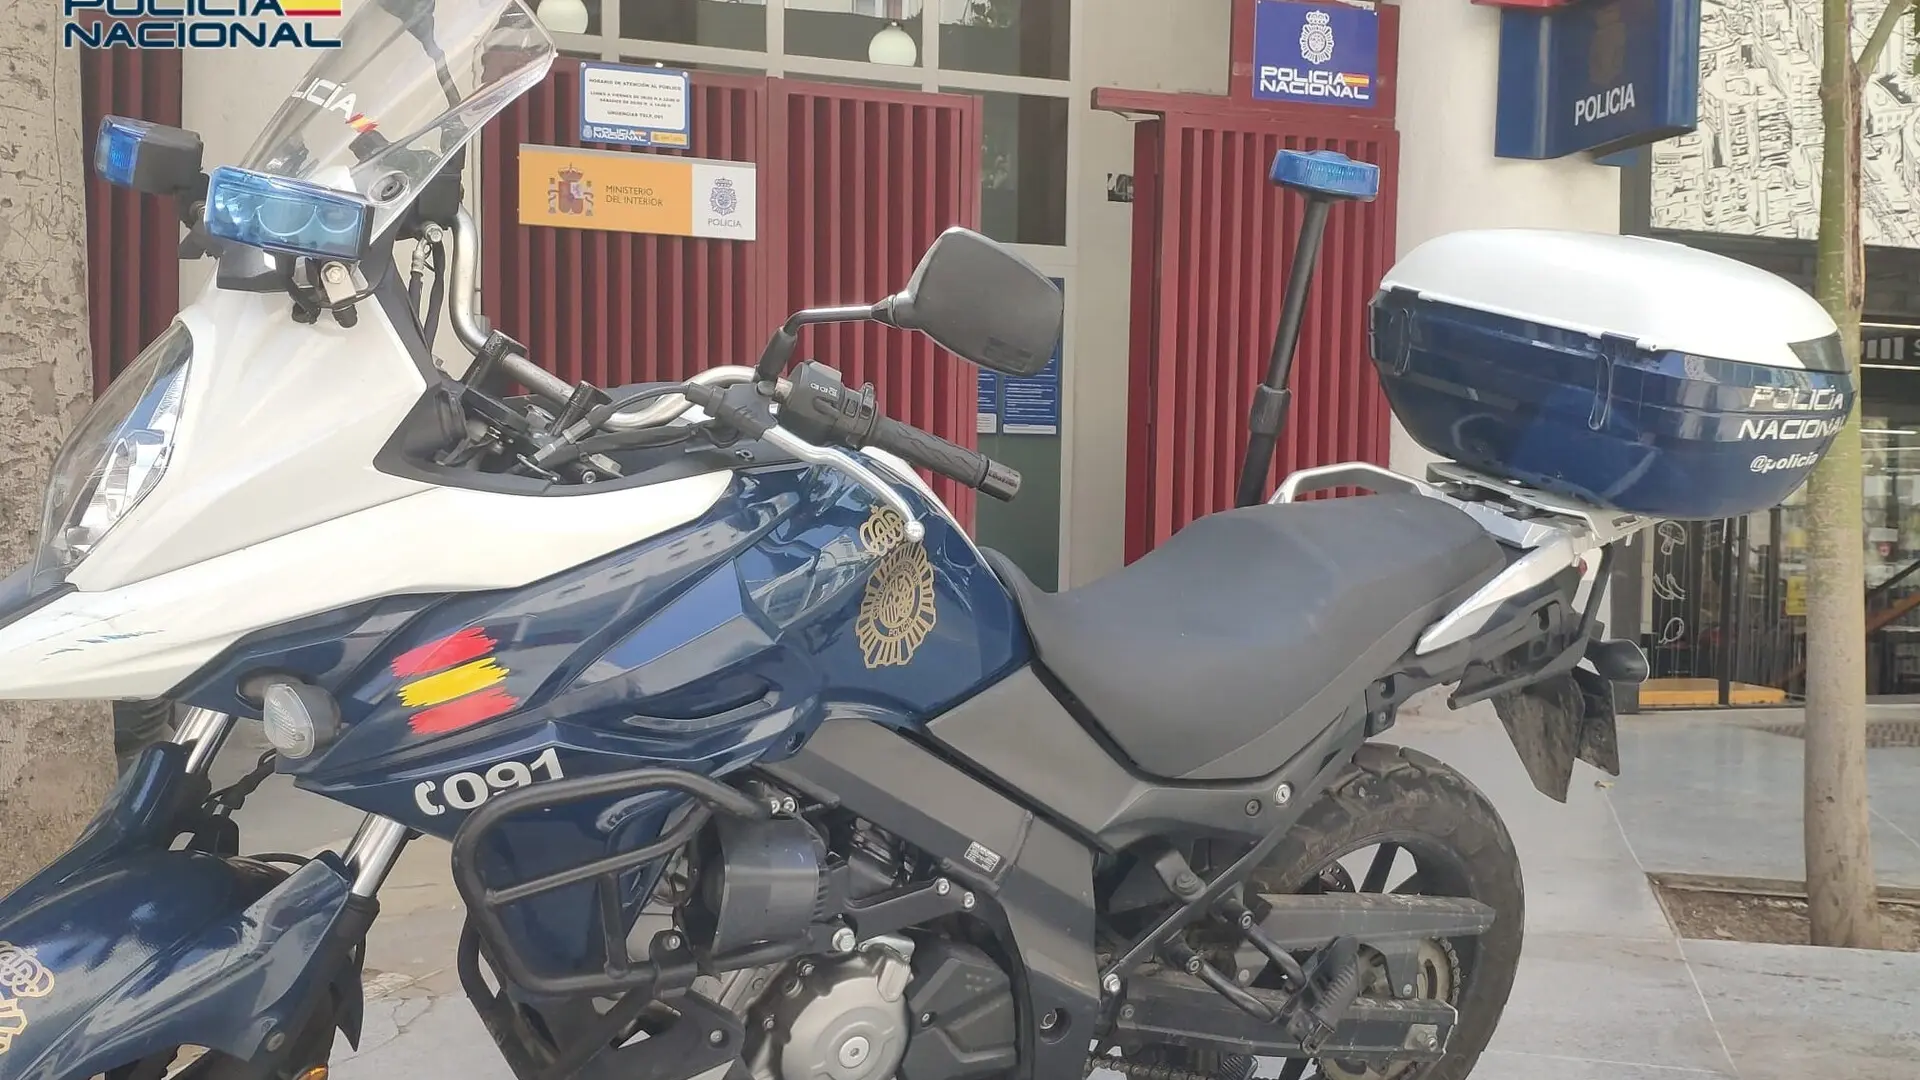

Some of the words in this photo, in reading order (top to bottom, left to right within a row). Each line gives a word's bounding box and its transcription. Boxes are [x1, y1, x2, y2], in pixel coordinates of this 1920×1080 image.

[1260, 80, 1369, 100] NACIONAL
[1574, 82, 1635, 126] POLICIA
[593, 132, 647, 141] NACIONAL
[606, 185, 653, 196] MINISTERIO
[606, 195, 620, 204] DEL
[624, 196, 663, 207] INTERIOR
[1750, 452, 1819, 474] @policia
[444, 748, 564, 810] 091
